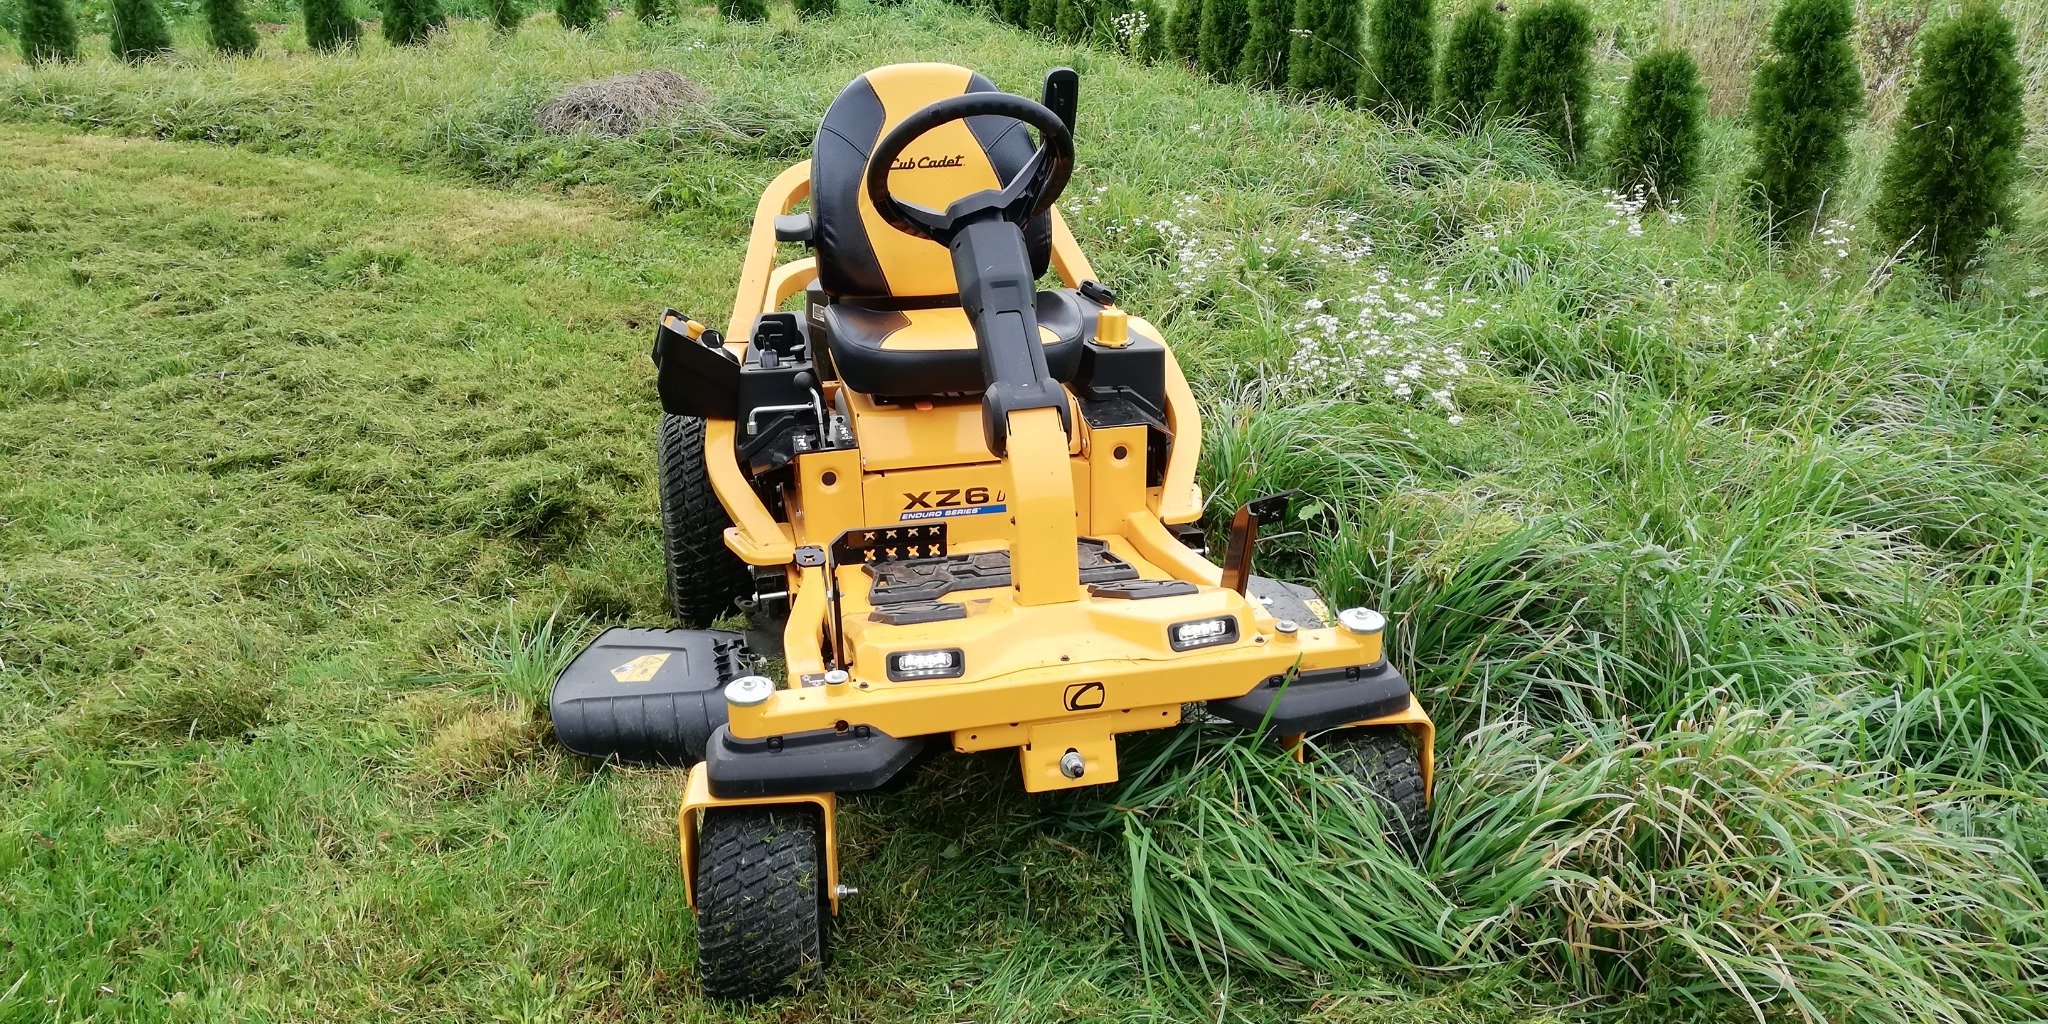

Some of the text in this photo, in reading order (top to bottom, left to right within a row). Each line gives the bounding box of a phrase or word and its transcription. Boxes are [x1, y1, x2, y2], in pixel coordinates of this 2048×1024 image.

[917, 155, 965, 168] Cadet
[902, 486, 990, 511] XZ6
[901, 507, 979, 520] ENDURO SERIES
